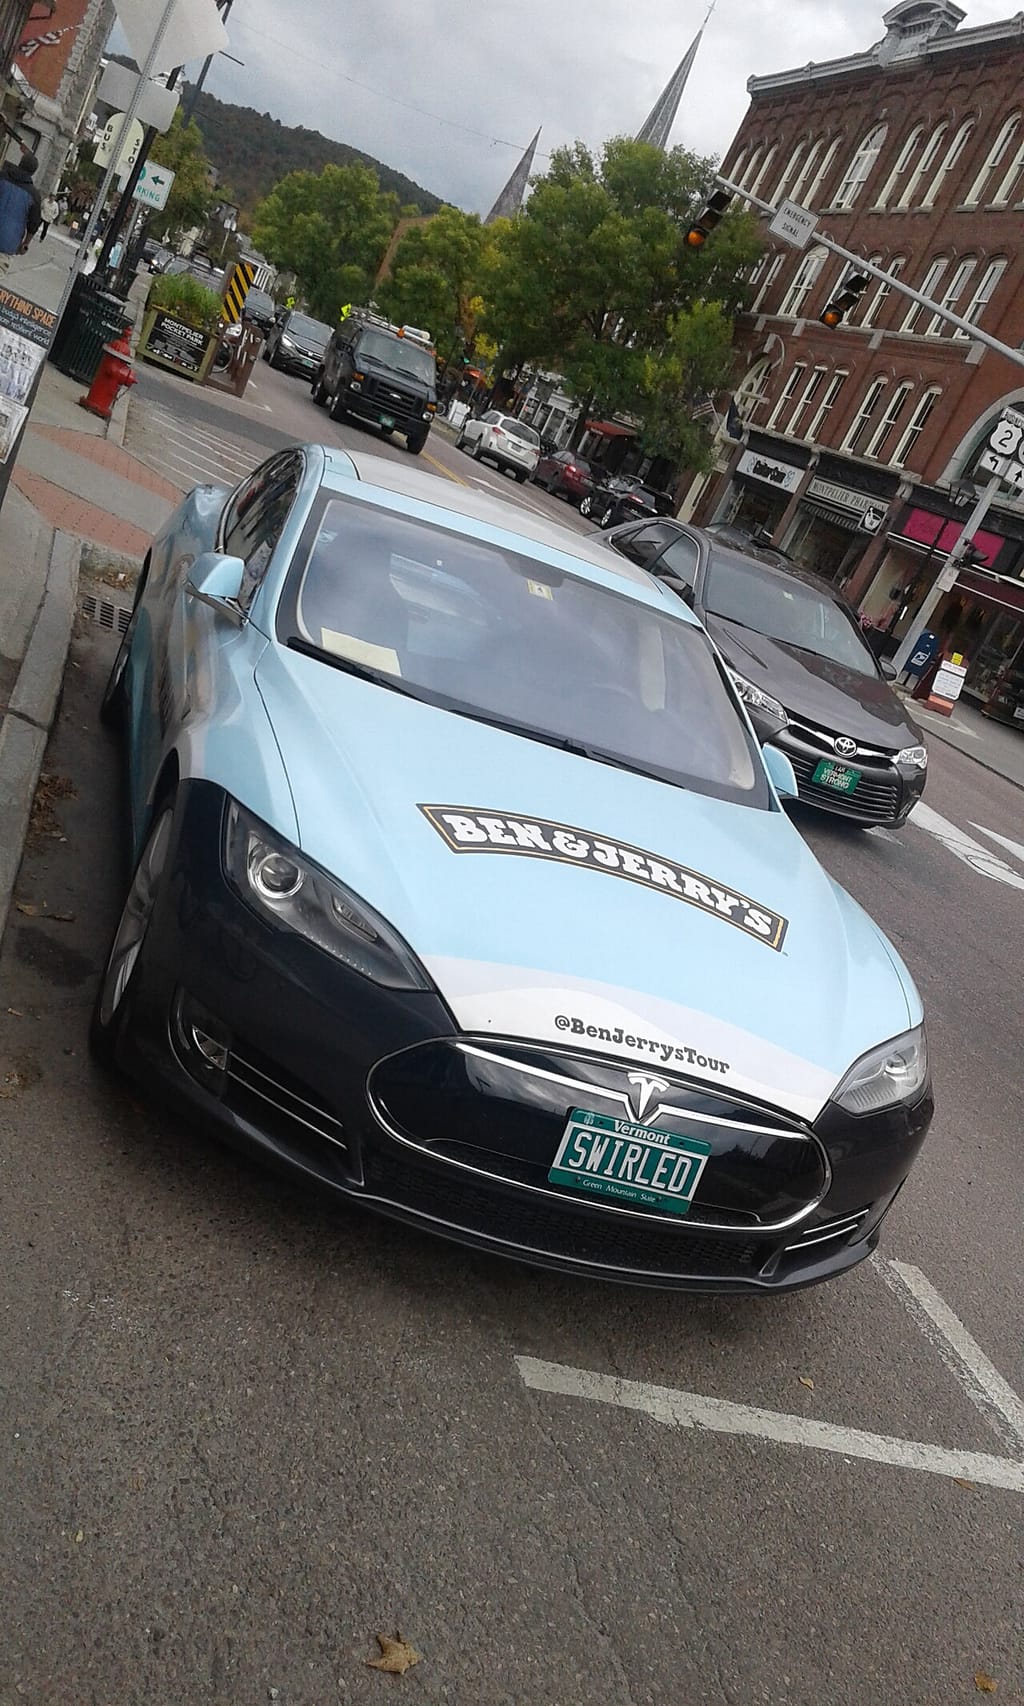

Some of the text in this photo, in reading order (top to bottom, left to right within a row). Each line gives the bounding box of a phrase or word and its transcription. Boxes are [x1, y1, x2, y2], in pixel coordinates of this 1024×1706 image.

[100, 124, 113, 151] BUS
[127, 138, 141, 165] STO
[136, 184, 161, 202] RKING
[783, 207, 811, 228] EMERGENCY
[782, 222, 800, 238] SIGNAL
[32, 306, 57, 329] SPACE
[163, 317, 204, 340] MONTPELIER
[160, 321, 186, 337] POCKET
[185, 333, 204, 346] PARK
[998, 429, 1013, 448] 2
[813, 481, 849, 503] MONTPELIER
[820, 774, 850, 789] STRONG
[823, 767, 853, 783] VERMONT
[555, 1015, 730, 1075] @BenJerrysTour
[614, 1119, 671, 1145] Vermont
[568, 1131, 693, 1193] SWIRLED
[582, 1179, 656, 1202] Green Mountain State
